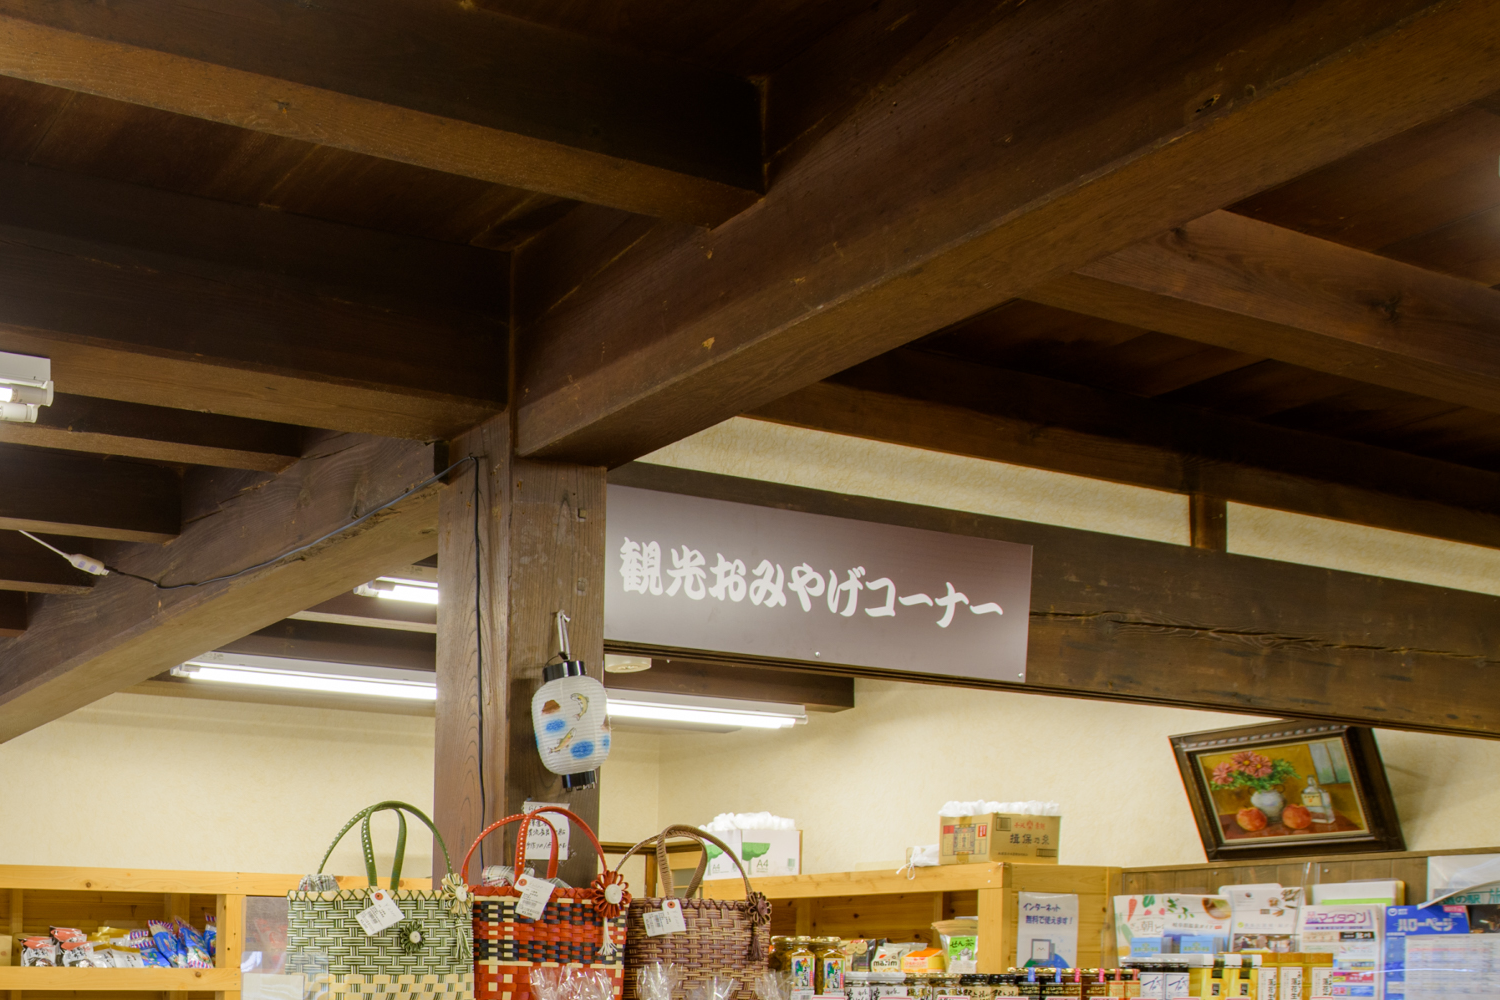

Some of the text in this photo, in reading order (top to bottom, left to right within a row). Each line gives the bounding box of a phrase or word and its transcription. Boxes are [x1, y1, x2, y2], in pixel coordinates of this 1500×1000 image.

[618, 536, 1004, 629] 観光おみやげコーナー
[755, 859, 769, 870] A4
[1022, 902, 1062, 912] インターネット
[1396, 917, 1454, 933] ハローページ
